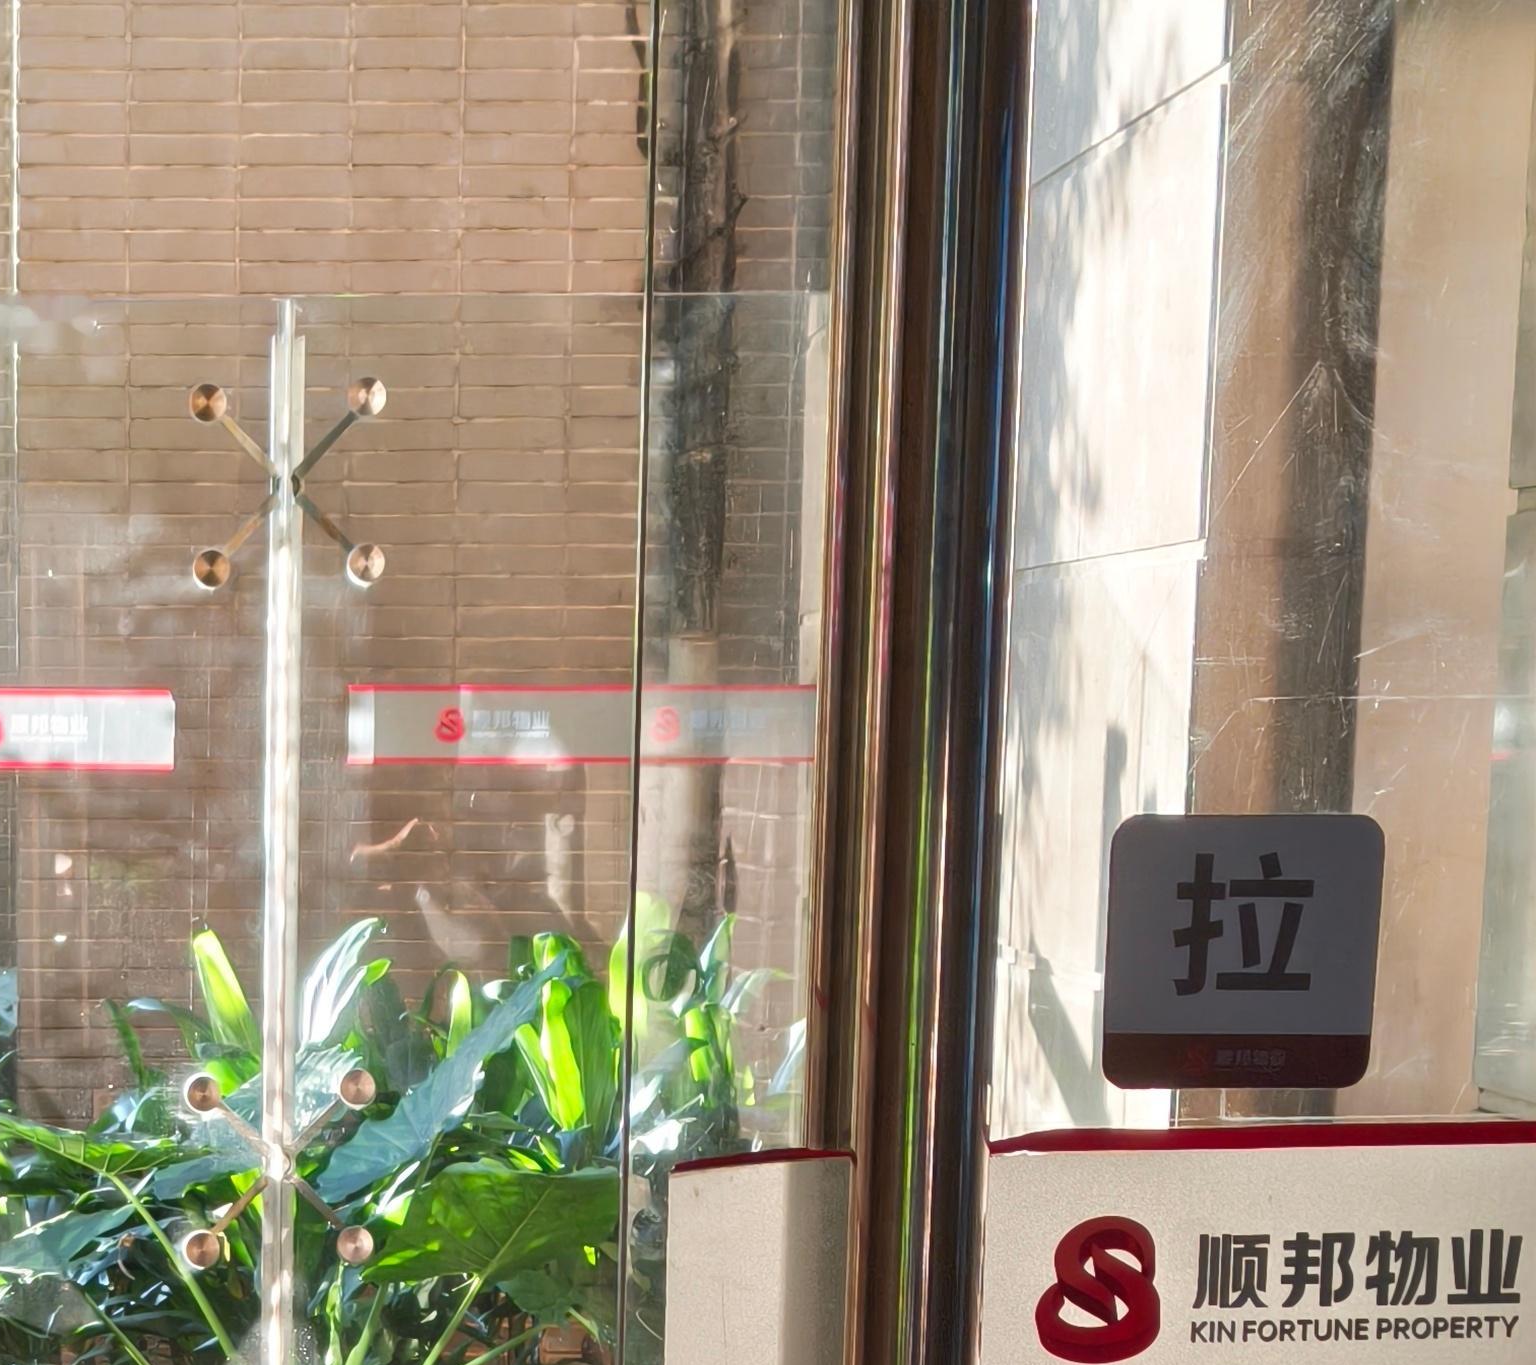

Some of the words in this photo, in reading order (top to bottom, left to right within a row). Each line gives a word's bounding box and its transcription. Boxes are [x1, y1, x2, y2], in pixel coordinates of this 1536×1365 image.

[1172, 852, 1314, 996] 拉
[1192, 1228, 1523, 1309] 顺邦物业
[1190, 1320, 1236, 1343] KIN
[1242, 1317, 1370, 1342] FORTUNE
[1376, 1315, 1520, 1341] PROPERTY
